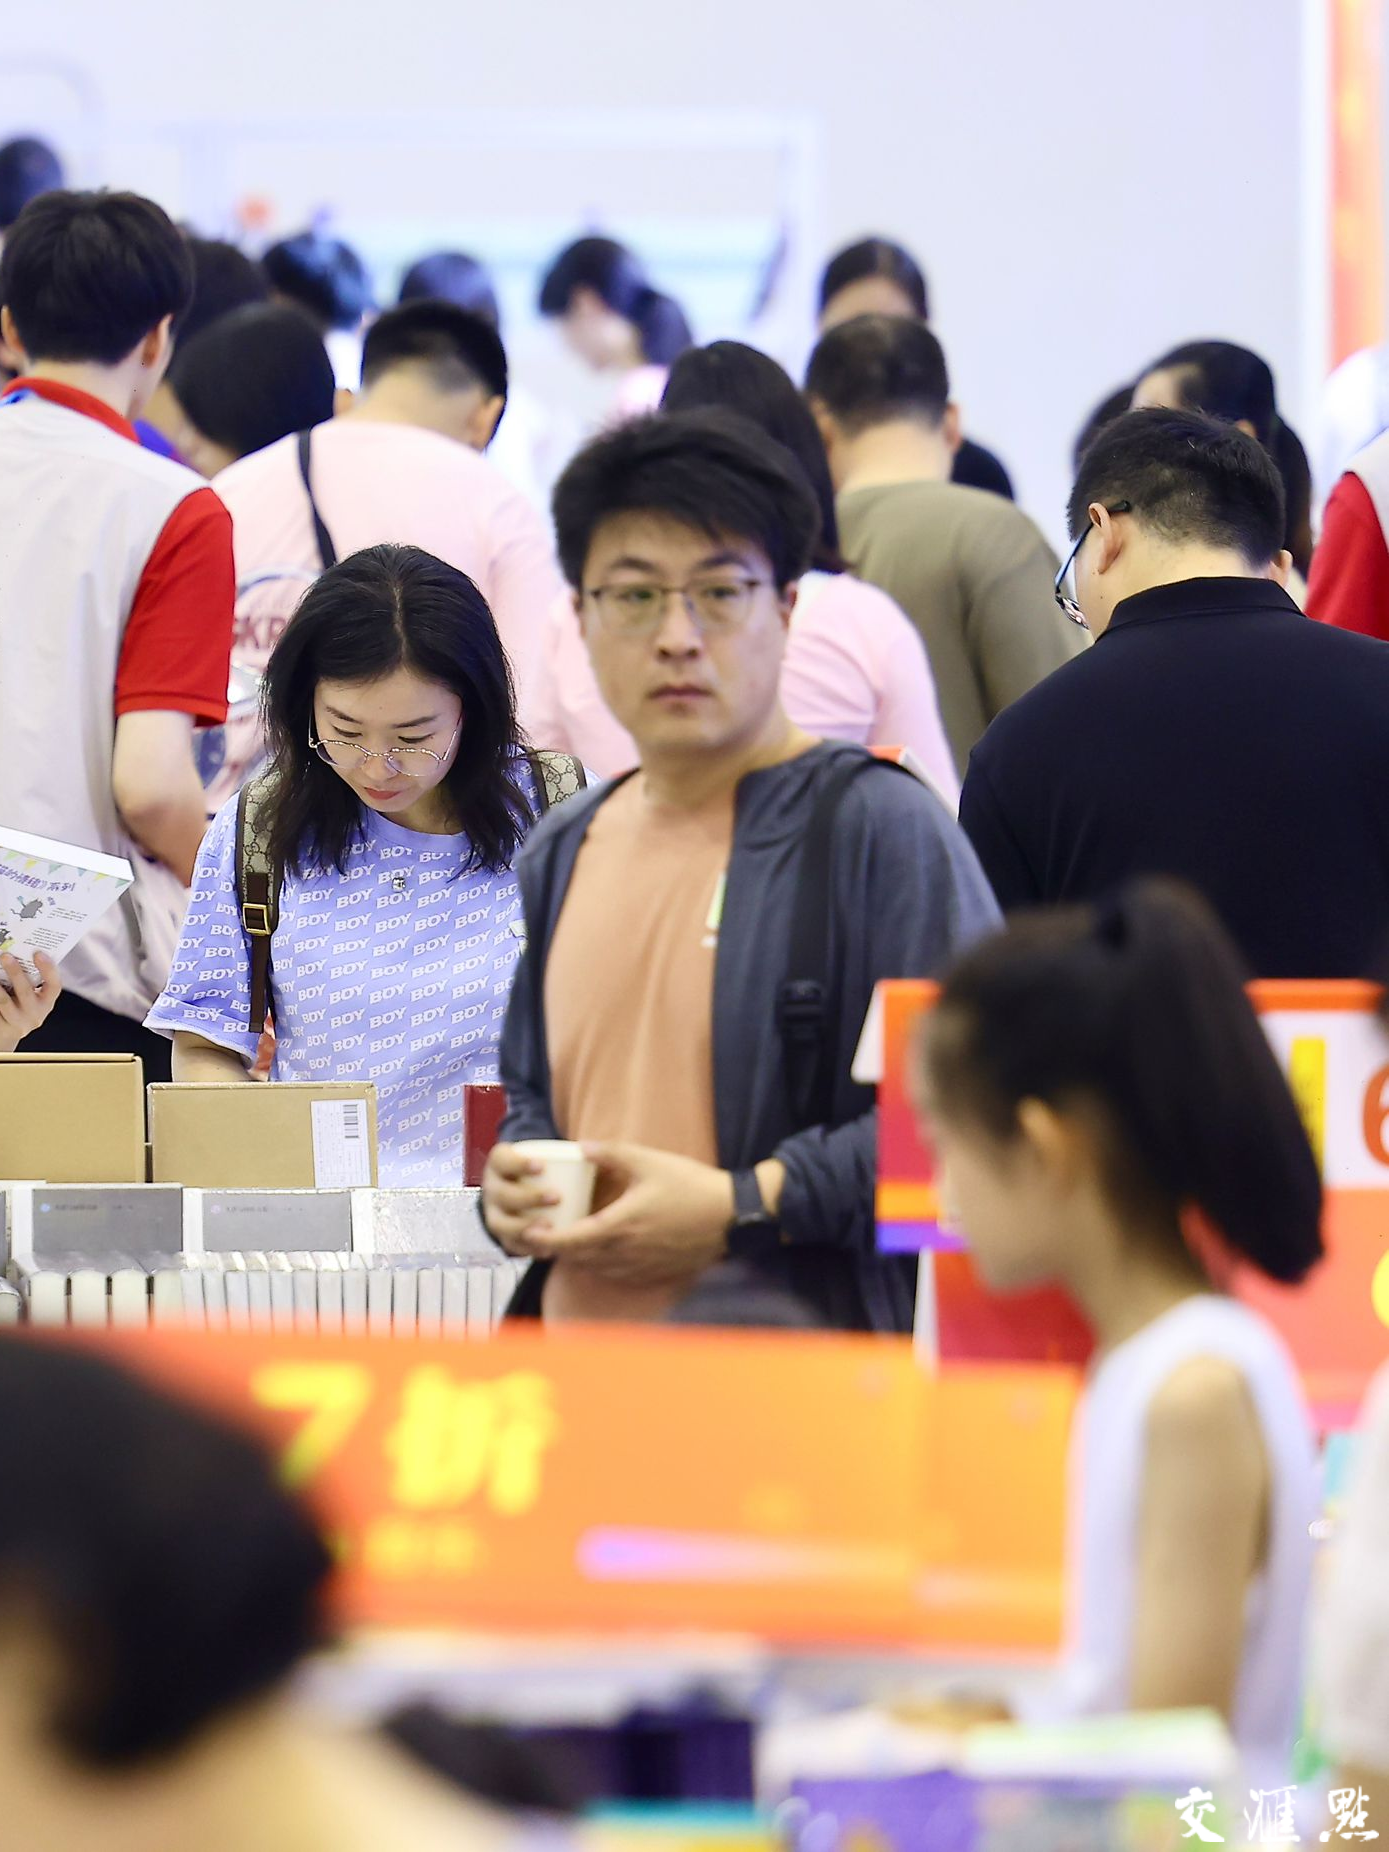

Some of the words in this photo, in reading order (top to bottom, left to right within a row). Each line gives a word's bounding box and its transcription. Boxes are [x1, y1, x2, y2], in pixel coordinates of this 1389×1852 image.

[197, 867, 221, 879] OY
[339, 864, 375, 884] BOY
[378, 865, 414, 884] BOY
[419, 867, 455, 885] BOY
[192, 890, 216, 902] OY
[299, 888, 334, 904] BOY
[337, 888, 373, 908] BOY
[376, 889, 414, 909] BOY
[417, 886, 454, 909] BOY
[457, 881, 492, 905] BOY
[495, 883, 519, 901] BO
[184, 914, 210, 926] OY
[296, 912, 332, 928] BOY
[335, 913, 372, 931] BOY
[375, 912, 411, 933] BOY
[415, 910, 452, 933] BOY
[455, 905, 492, 929] BOY
[178, 937, 204, 949] OY
[294, 936, 330, 954] BOY
[332, 937, 371, 955] BOY
[413, 934, 451, 956] BOY
[454, 930, 491, 953] BOY
[493, 927, 512, 946] BO
[204, 947, 236, 958] BOY
[373, 936, 410, 957] BOY
[173, 960, 198, 973] OY
[274, 957, 293, 972] BOY
[297, 959, 327, 977] BOY
[331, 959, 368, 979] BOY
[371, 960, 409, 979] BOY
[411, 957, 450, 978] BOY
[453, 952, 489, 975] BOY
[198, 969, 236, 981] BOY
[193, 989, 232, 1000] BOY
[298, 983, 326, 1002] BOY
[330, 982, 366, 1005] BOY
[370, 982, 407, 1004] BOY
[411, 979, 449, 1002] BOY
[452, 975, 489, 999] BOY
[493, 976, 514, 995] BO
[160, 996, 180, 1008] OY
[231, 1000, 250, 1012] BO
[183, 1008, 224, 1021] BOY
[302, 1008, 326, 1024] BOY
[331, 1008, 365, 1029] BOY
[370, 1007, 407, 1029] BOY
[411, 1003, 449, 1027] BOY
[452, 1000, 489, 1024] BOY
[223, 1023, 249, 1033] BO
[451, 1024, 487, 1049] BOY
[307, 1032, 328, 1047] BOY
[332, 1032, 366, 1053] BOY
[370, 1031, 407, 1054] BOY
[411, 1028, 448, 1052] BOY
[308, 1055, 332, 1070] BOY
[337, 1058, 365, 1075] BOY
[369, 1056, 406, 1079] BOY
[474, 1063, 498, 1079] BO
[437, 1085, 462, 1103] BO
[398, 1108, 433, 1132] BOY
[437, 1108, 462, 1127] BO
[399, 1133, 434, 1157] BOY
[439, 1133, 462, 1151] BO
[401, 1157, 435, 1177] BOY
[441, 1156, 462, 1174] BO
